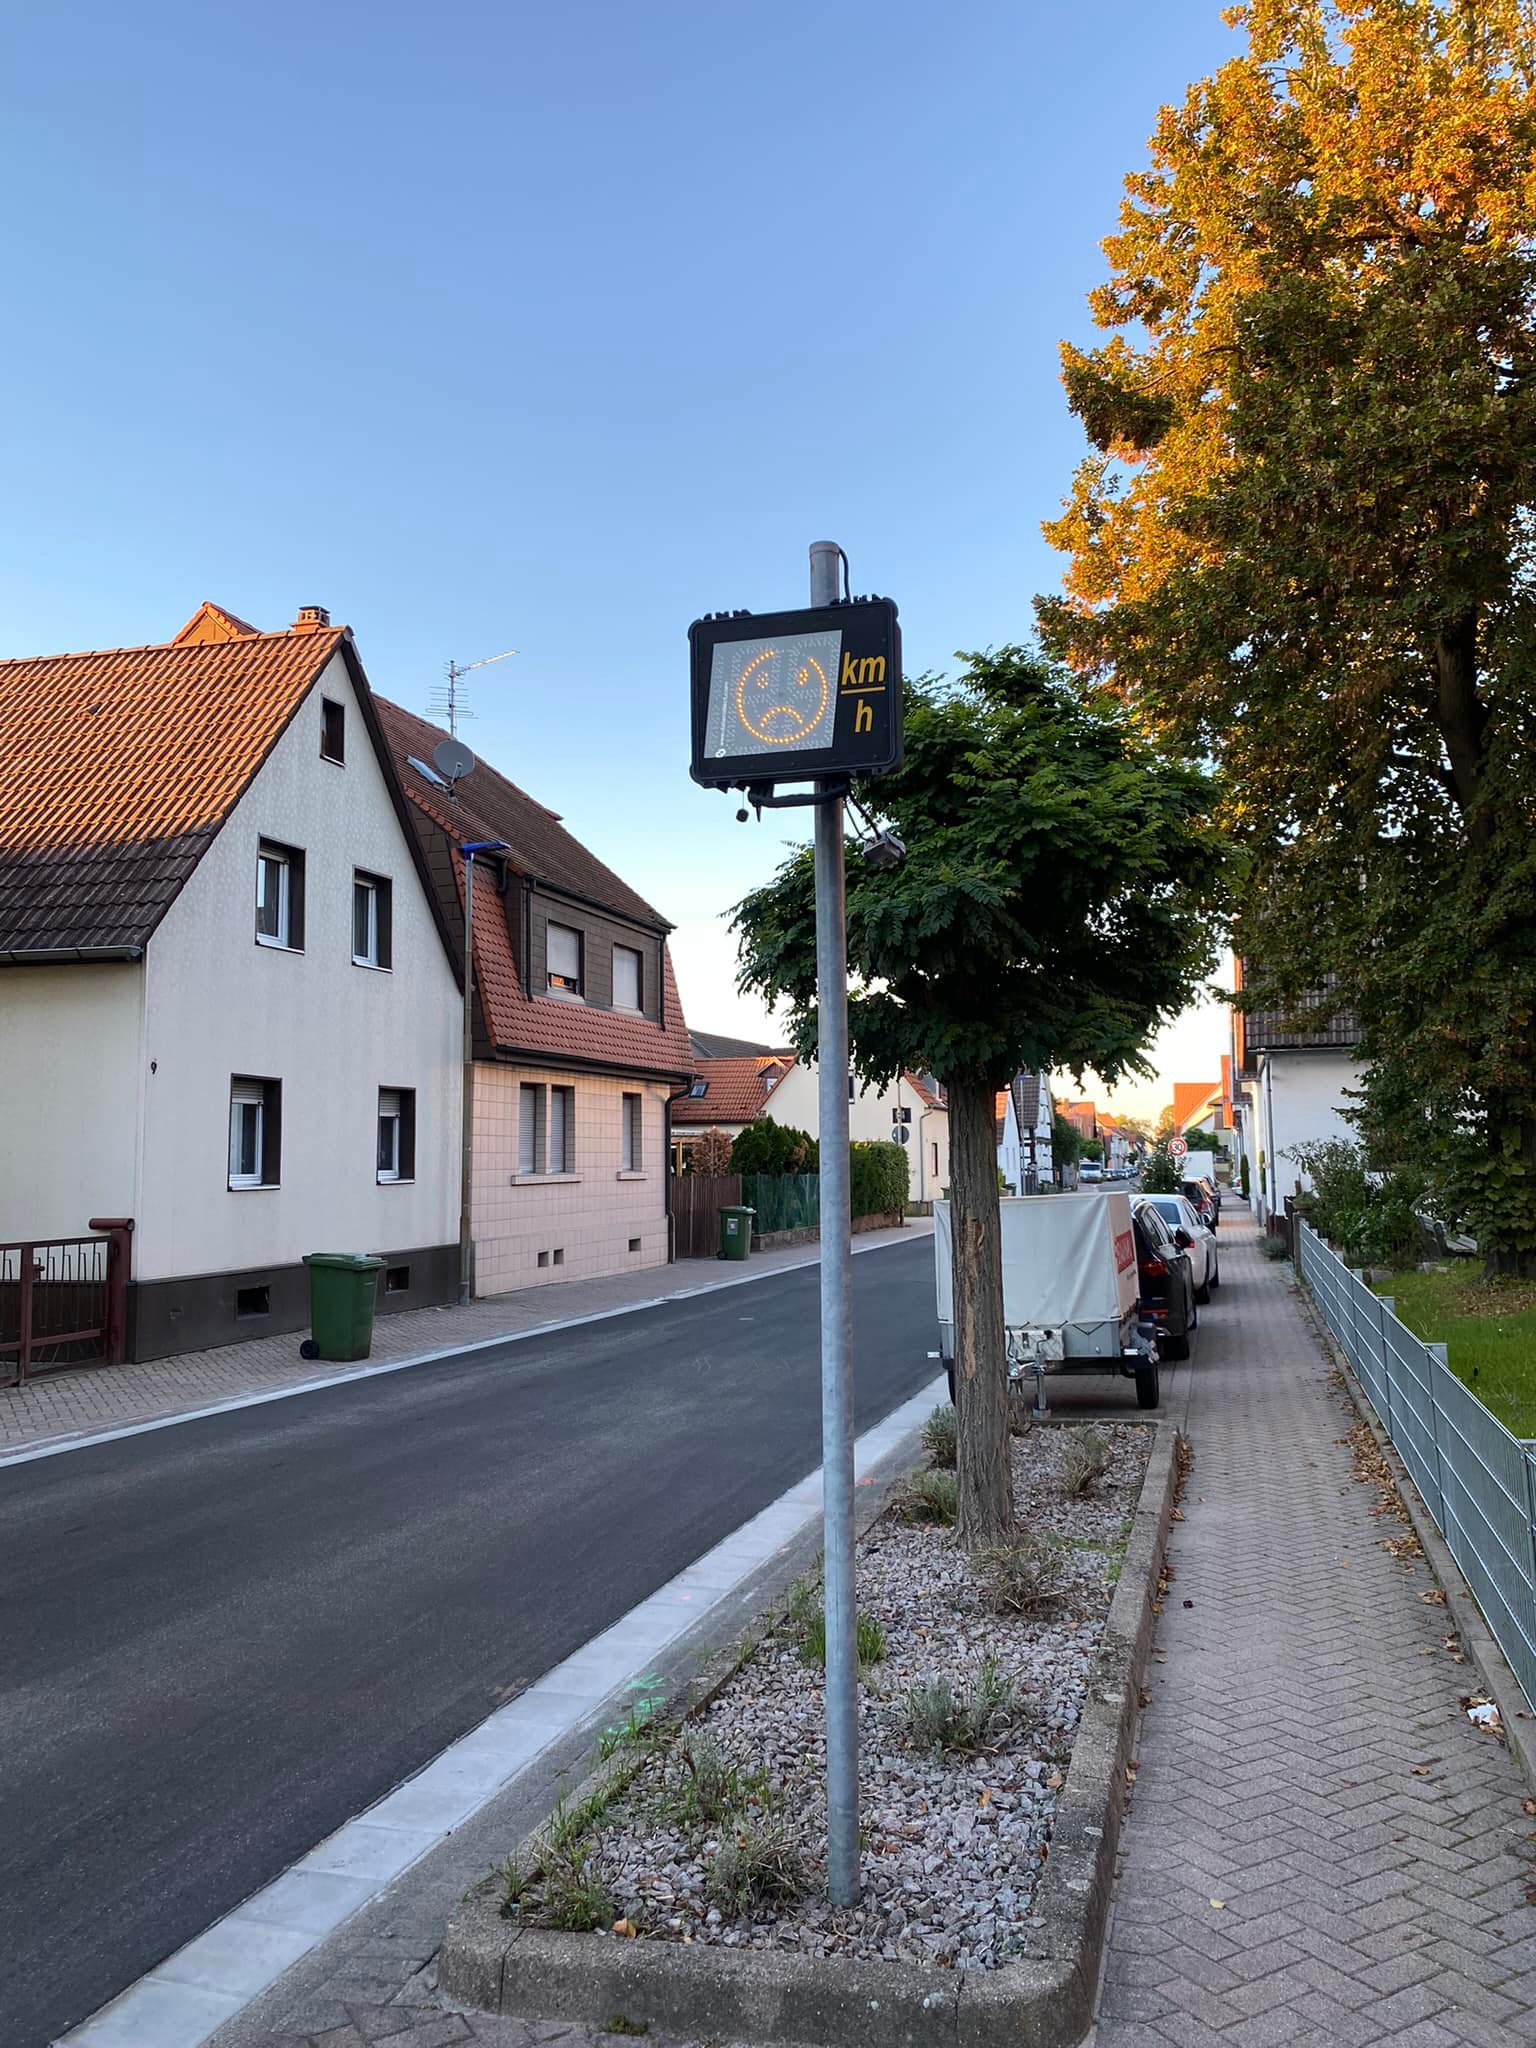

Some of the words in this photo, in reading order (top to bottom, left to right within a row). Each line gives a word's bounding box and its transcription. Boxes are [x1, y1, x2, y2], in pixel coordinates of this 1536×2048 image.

[841, 651, 886, 686] km
[855, 699, 873, 733] h
[150, 1061, 157, 1075] 9
[1172, 1143, 1183, 1152] 30
